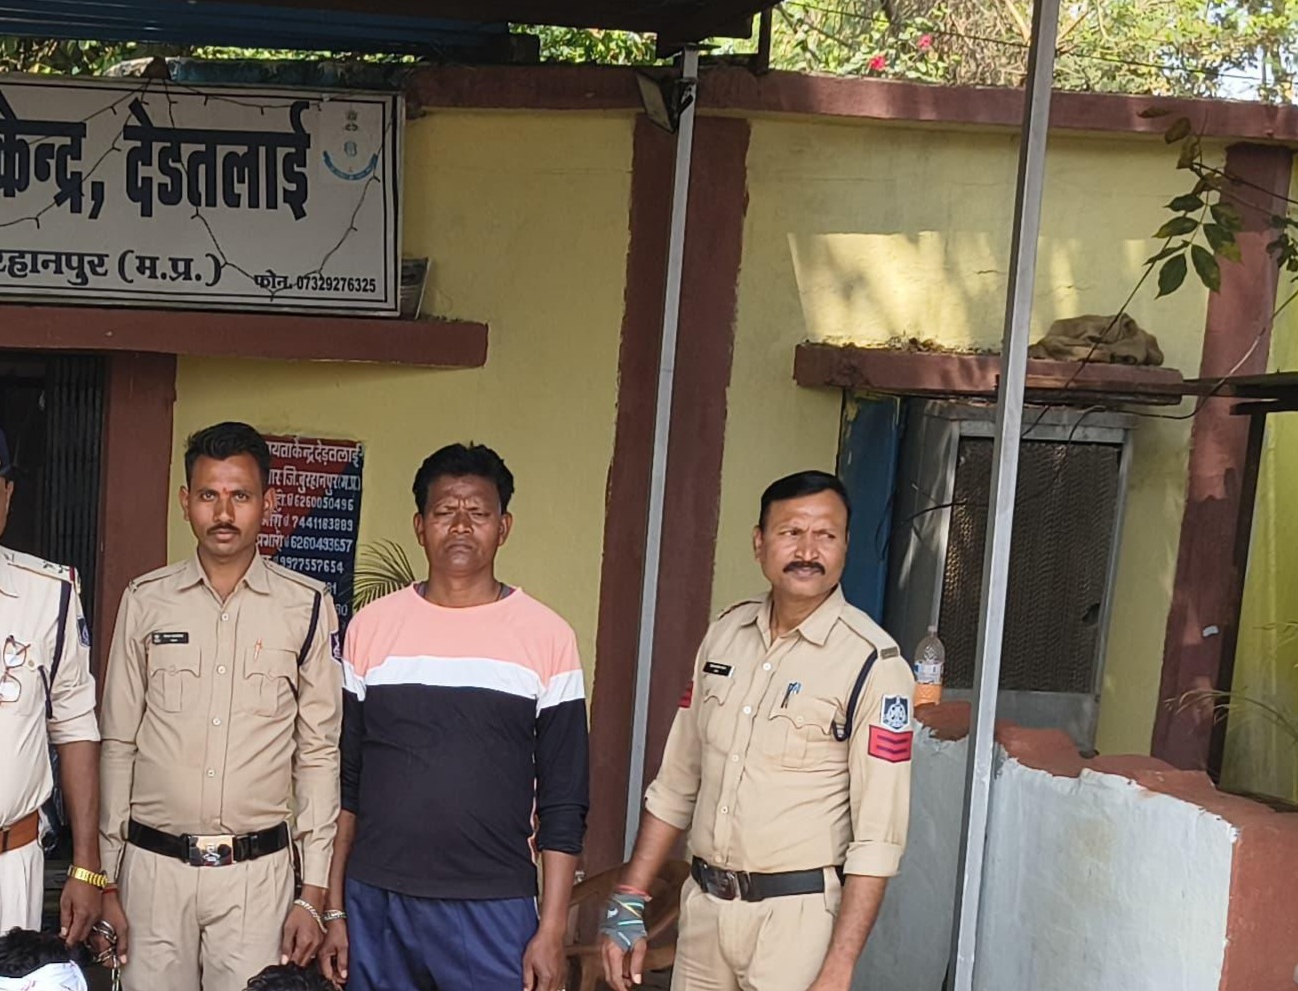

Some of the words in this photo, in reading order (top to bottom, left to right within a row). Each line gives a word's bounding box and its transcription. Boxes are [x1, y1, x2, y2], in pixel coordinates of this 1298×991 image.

[123, 98, 310, 220] देडतलाई
[117, 250, 223, 286] (म.प्र.)
[296, 275, 376, 293] 07329276325
